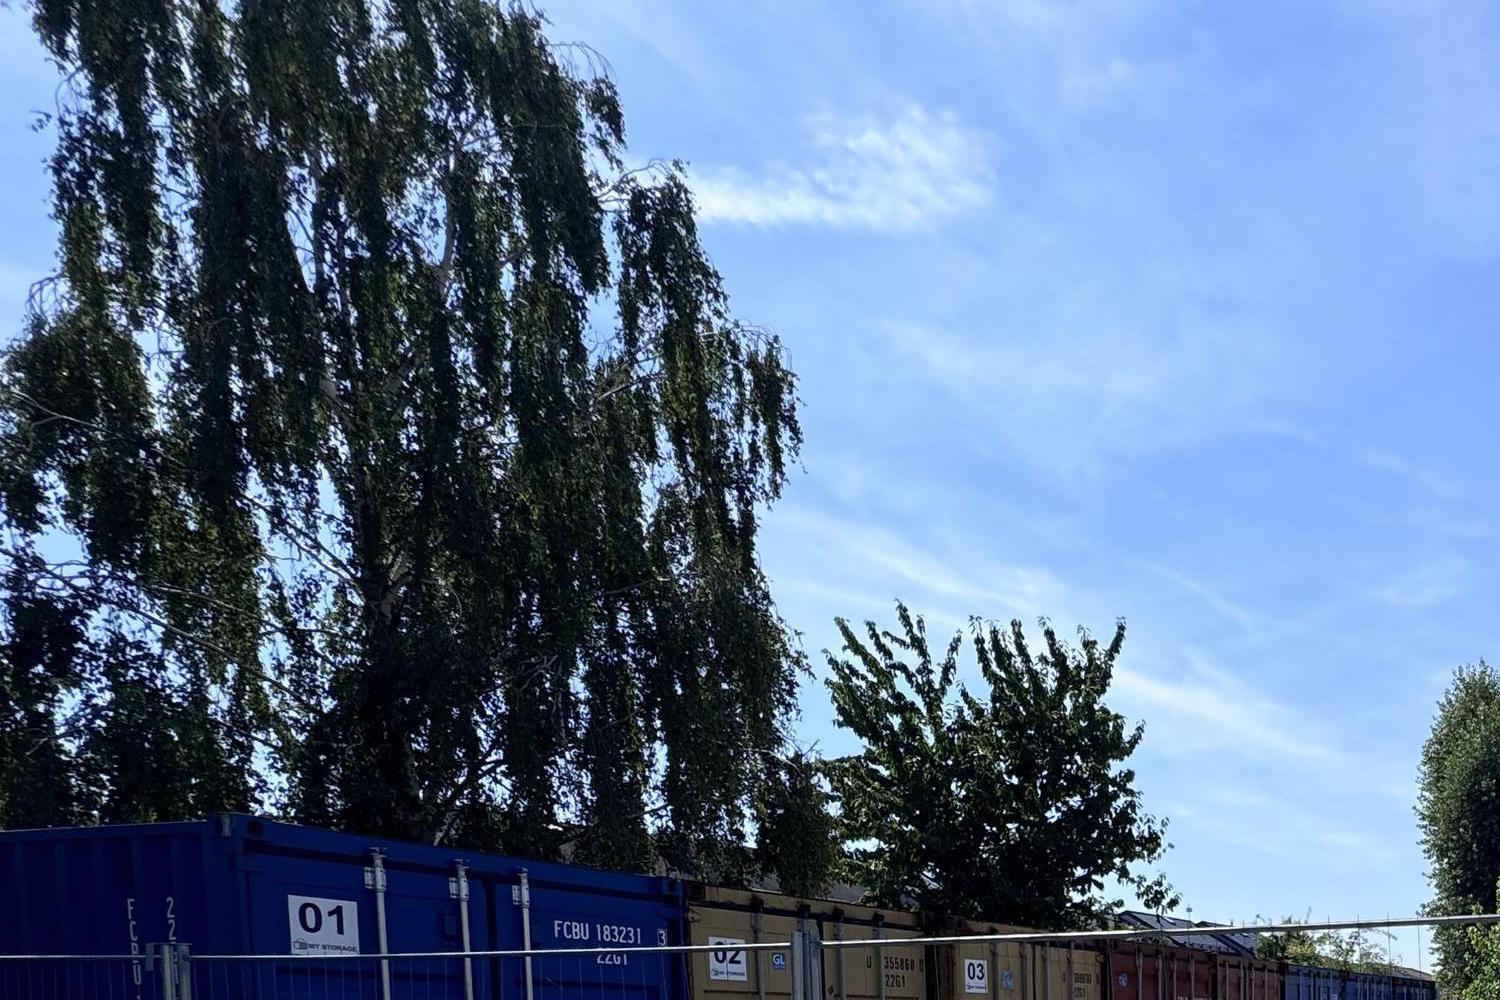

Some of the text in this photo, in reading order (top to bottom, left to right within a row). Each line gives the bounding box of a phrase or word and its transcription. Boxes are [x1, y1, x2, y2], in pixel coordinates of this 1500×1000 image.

[299, 902, 344, 935] 01
[127, 898, 142, 985] FCBU
[554, 920, 667, 947] FCBU 183231 3
[714, 941, 741, 965] 02
[885, 974, 905, 987] 22G1
[967, 962, 985, 980] 03
